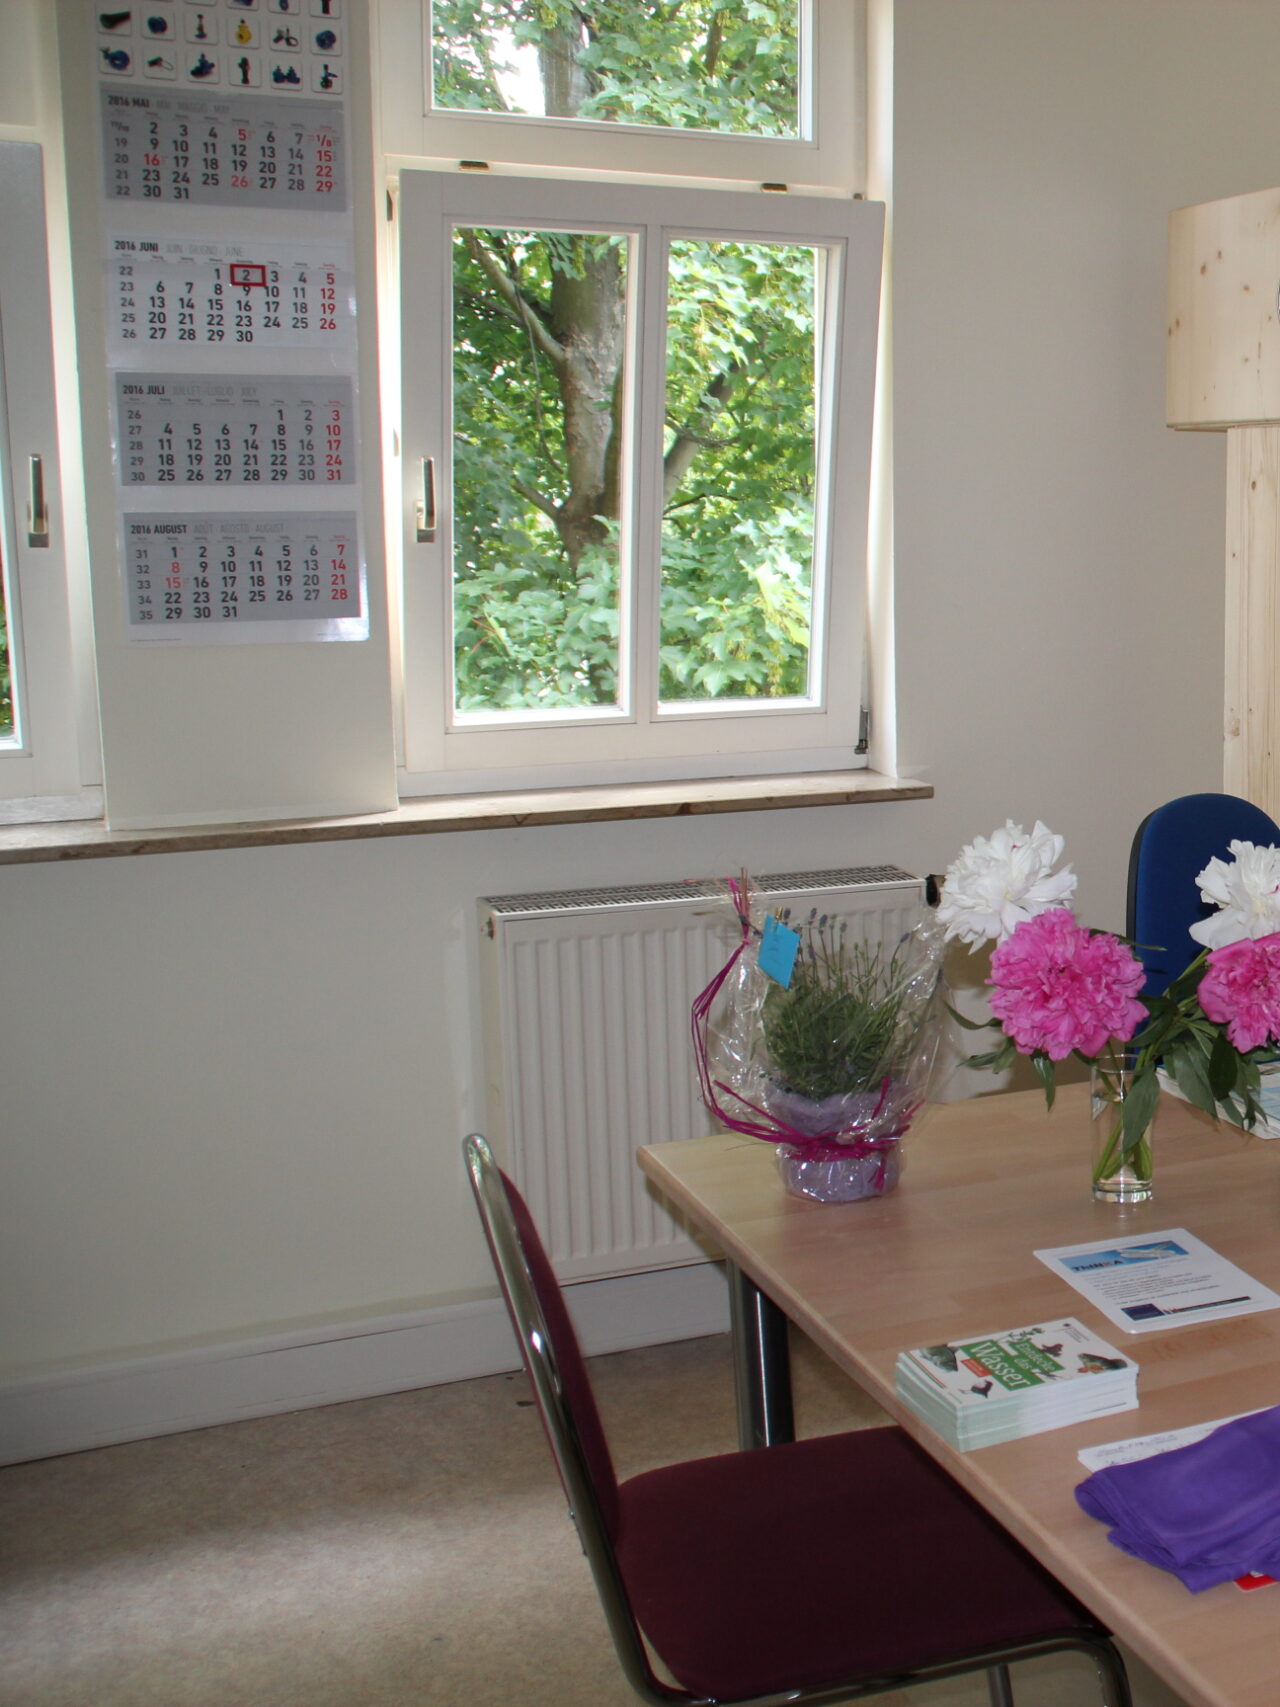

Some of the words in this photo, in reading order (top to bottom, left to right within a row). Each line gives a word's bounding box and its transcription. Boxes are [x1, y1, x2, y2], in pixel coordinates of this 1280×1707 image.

[108, 96, 130, 107] 2016
[132, 98, 150, 108] MAI
[149, 122, 158, 135] 2
[179, 124, 188, 137] 3
[208, 127, 218, 139] 4
[238, 128, 247, 141] 5
[266, 131, 275, 143] 6
[294, 132, 303, 144] 7
[150, 137, 159, 150] 9
[172, 139, 189, 152] 10
[203, 142, 216, 155] 11
[231, 144, 247, 157] 12
[260, 145, 276, 158] 13
[288, 147, 304, 160] 14
[317, 150, 332, 162] 15
[144, 153, 160, 166] 16
[173, 155, 189, 168] 17
[202, 157, 219, 170] 18
[232, 159, 248, 172] 19
[259, 161, 276, 174] 20
[288, 163, 303, 176] 21
[316, 165, 332, 178] 22
[142, 169, 160, 182] 23
[172, 171, 190, 184] 24
[202, 173, 219, 186] 25
[231, 175, 248, 188] 26
[259, 177, 276, 189] 27
[288, 178, 305, 191] 28
[316, 180, 333, 192] 29
[143, 184, 161, 198] 30
[174, 186, 189, 199] 31
[114, 240, 137, 251] 2016
[138, 242, 159, 253] JUNI
[214, 268, 220, 280] 1
[241, 269, 251, 281] 2
[270, 270, 279, 283] 3
[298, 272, 307, 284] 4
[326, 273, 335, 285] 5
[156, 281, 165, 293] 6
[185, 282, 194, 294] 7
[214, 283, 223, 295] 8
[243, 285, 251, 297] 9
[264, 286, 279, 298] 10
[293, 287, 305, 298] 11
[321, 288, 335, 300] 12
[149, 296, 165, 308] 13
[179, 297, 195, 309] 14
[208, 298, 223, 311] 15
[236, 300, 252, 312] 16
[265, 301, 280, 312] 17
[292, 302, 308, 314] 18
[321, 303, 336, 315] 19
[148, 311, 166, 324] 20
[178, 312, 193, 325] 21
[207, 314, 224, 326] 22
[235, 315, 252, 327] 23
[264, 316, 281, 328] 24
[292, 317, 308, 329] 25
[320, 318, 336, 330] 26
[149, 327, 166, 339] 27
[177, 328, 196, 341] 28
[207, 329, 224, 341] 29
[236, 330, 253, 342] 30
[122, 385, 144, 395] 2016
[146, 385, 165, 395] JULI
[277, 409, 283, 421] 1
[304, 409, 312, 421] 2
[332, 410, 340, 421] 3
[163, 423, 173, 435] 4
[192, 423, 201, 435] 5
[221, 424, 230, 435] 6
[249, 424, 258, 435] 7
[277, 424, 286, 436] 8
[305, 424, 313, 436] 9
[326, 424, 341, 436] 10
[128, 440, 143, 450] 28
[158, 438, 172, 450] 11
[186, 438, 202, 451] 12
[215, 438, 231, 451] 13
[243, 439, 259, 451] 14
[271, 439, 287, 451] 15
[299, 439, 314, 451] 16
[327, 439, 341, 451] 17
[130, 456, 144, 466] 29
[158, 454, 174, 466] 18
[187, 454, 203, 465] 19
[214, 454, 231, 466] 20
[243, 454, 258, 466] 21
[270, 454, 287, 466] 22
[298, 454, 315, 466] 23
[326, 454, 342, 466] 24
[131, 472, 145, 481] 30
[158, 469, 175, 481] 25
[186, 469, 204, 481] 26
[215, 469, 232, 481] 27
[243, 469, 260, 481] 28
[271, 469, 288, 481] 29
[299, 469, 315, 481] 30
[327, 469, 341, 480] 31
[130, 524, 152, 535] 2016
[154, 524, 187, 534] AUGUST
[171, 546, 177, 558] 1
[199, 546, 207, 558] 2
[227, 546, 235, 558] 3
[254, 545, 263, 557] 4
[282, 545, 290, 557] 5
[309, 545, 318, 556] 6
[337, 544, 345, 555] 7
[171, 561, 180, 574] 8
[199, 561, 208, 573] 9
[220, 561, 236, 572] 10
[249, 560, 262, 572] 11
[276, 560, 291, 571] 12
[304, 559, 319, 571] 13
[331, 559, 346, 570] 14
[166, 577, 181, 589] 15
[193, 577, 209, 588] 16
[222, 576, 237, 587] 17
[249, 575, 265, 587] 18
[277, 575, 292, 586] 19
[303, 574, 320, 586] 20
[331, 574, 345, 585] 21
[164, 592, 182, 604] 22
[193, 591, 210, 603] 23
[221, 591, 238, 603] 24
[249, 590, 266, 602] 25
[276, 590, 293, 601] 26
[304, 589, 320, 601] 27
[331, 588, 348, 600] 28
[165, 607, 182, 619] 29
[194, 606, 211, 618] 30
[222, 606, 237, 618] 31
[970, 1342, 1031, 1387] Wasser
[1016, 1343, 1056, 1371] Entdecke
